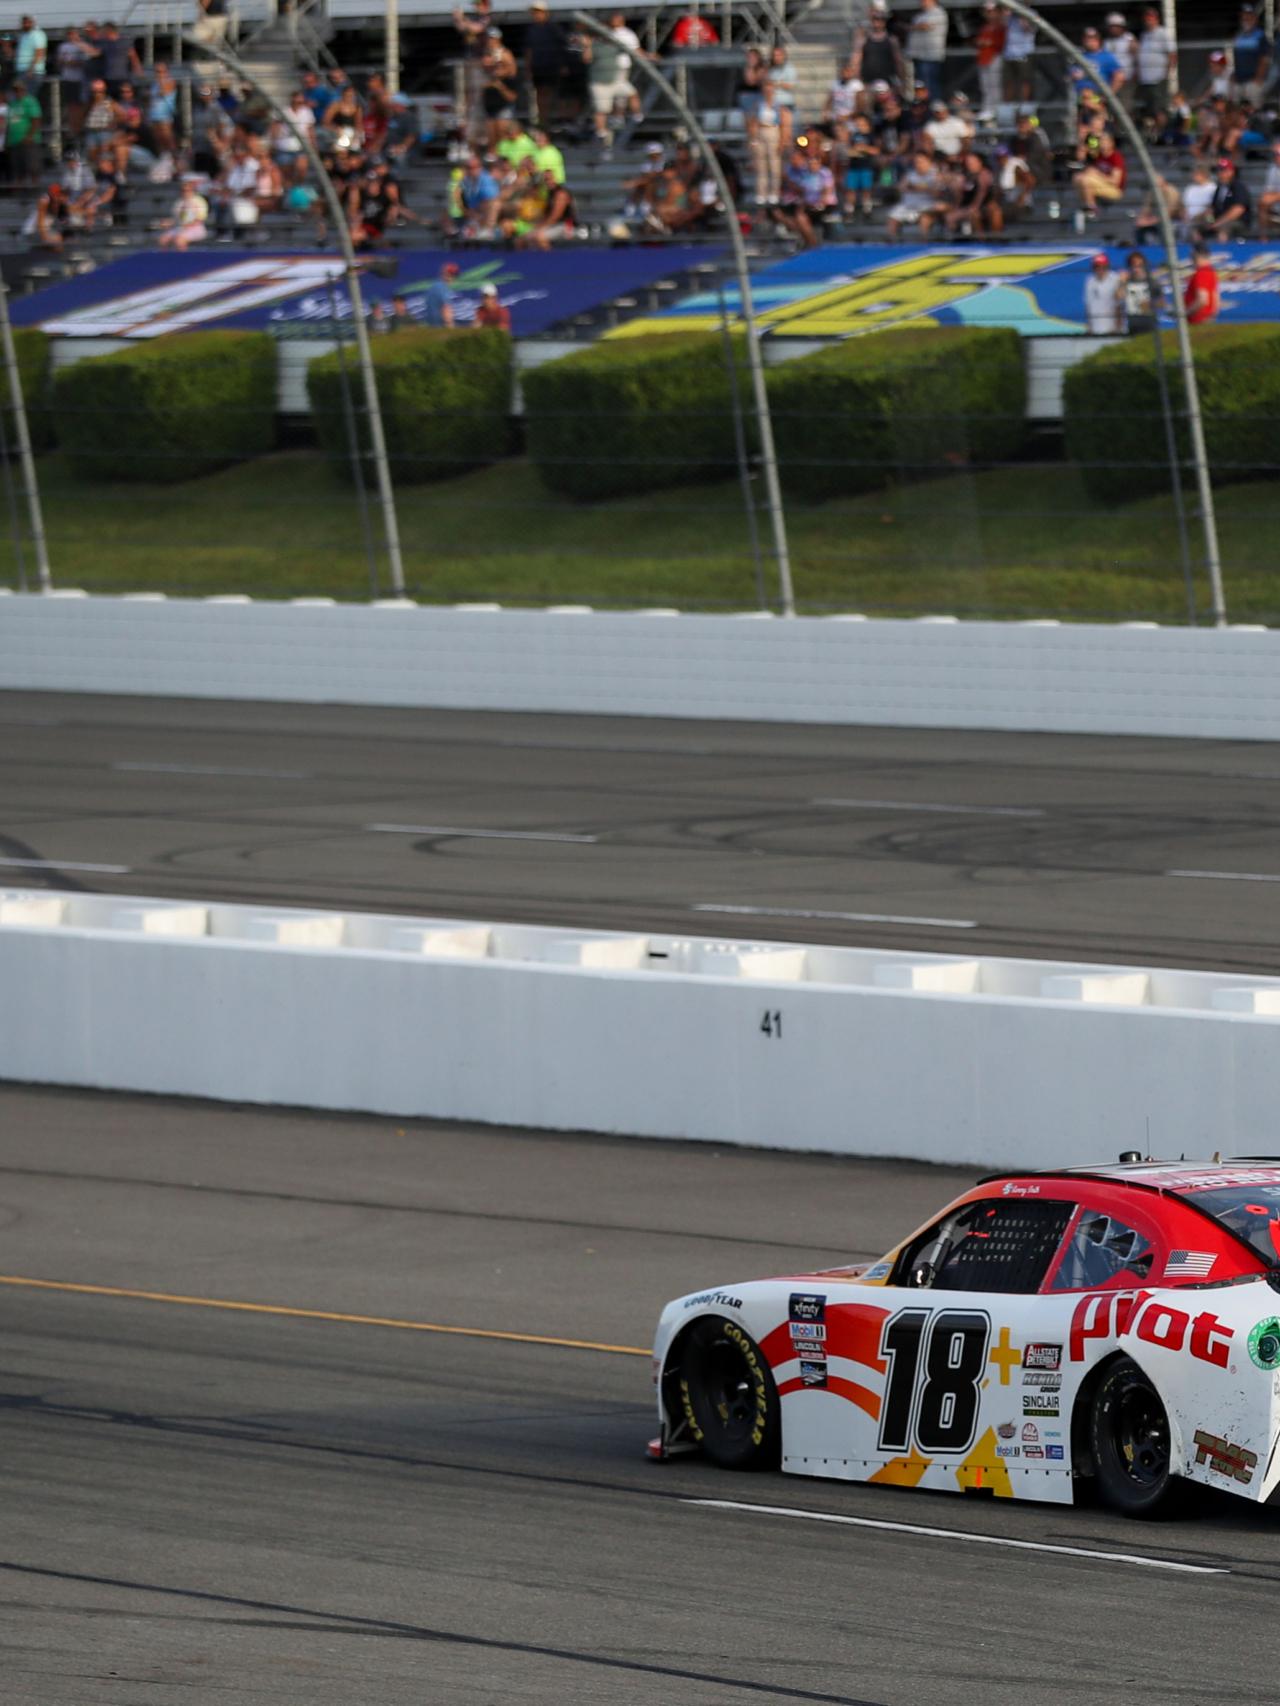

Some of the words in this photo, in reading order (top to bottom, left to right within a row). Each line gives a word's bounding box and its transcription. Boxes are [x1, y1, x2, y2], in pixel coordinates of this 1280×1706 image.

[760, 1009, 782, 1039] 41
[791, 1323, 814, 1337] Mobil
[876, 1306, 992, 1455] 18
[1022, 1395, 1060, 1409] SINCLAIR
